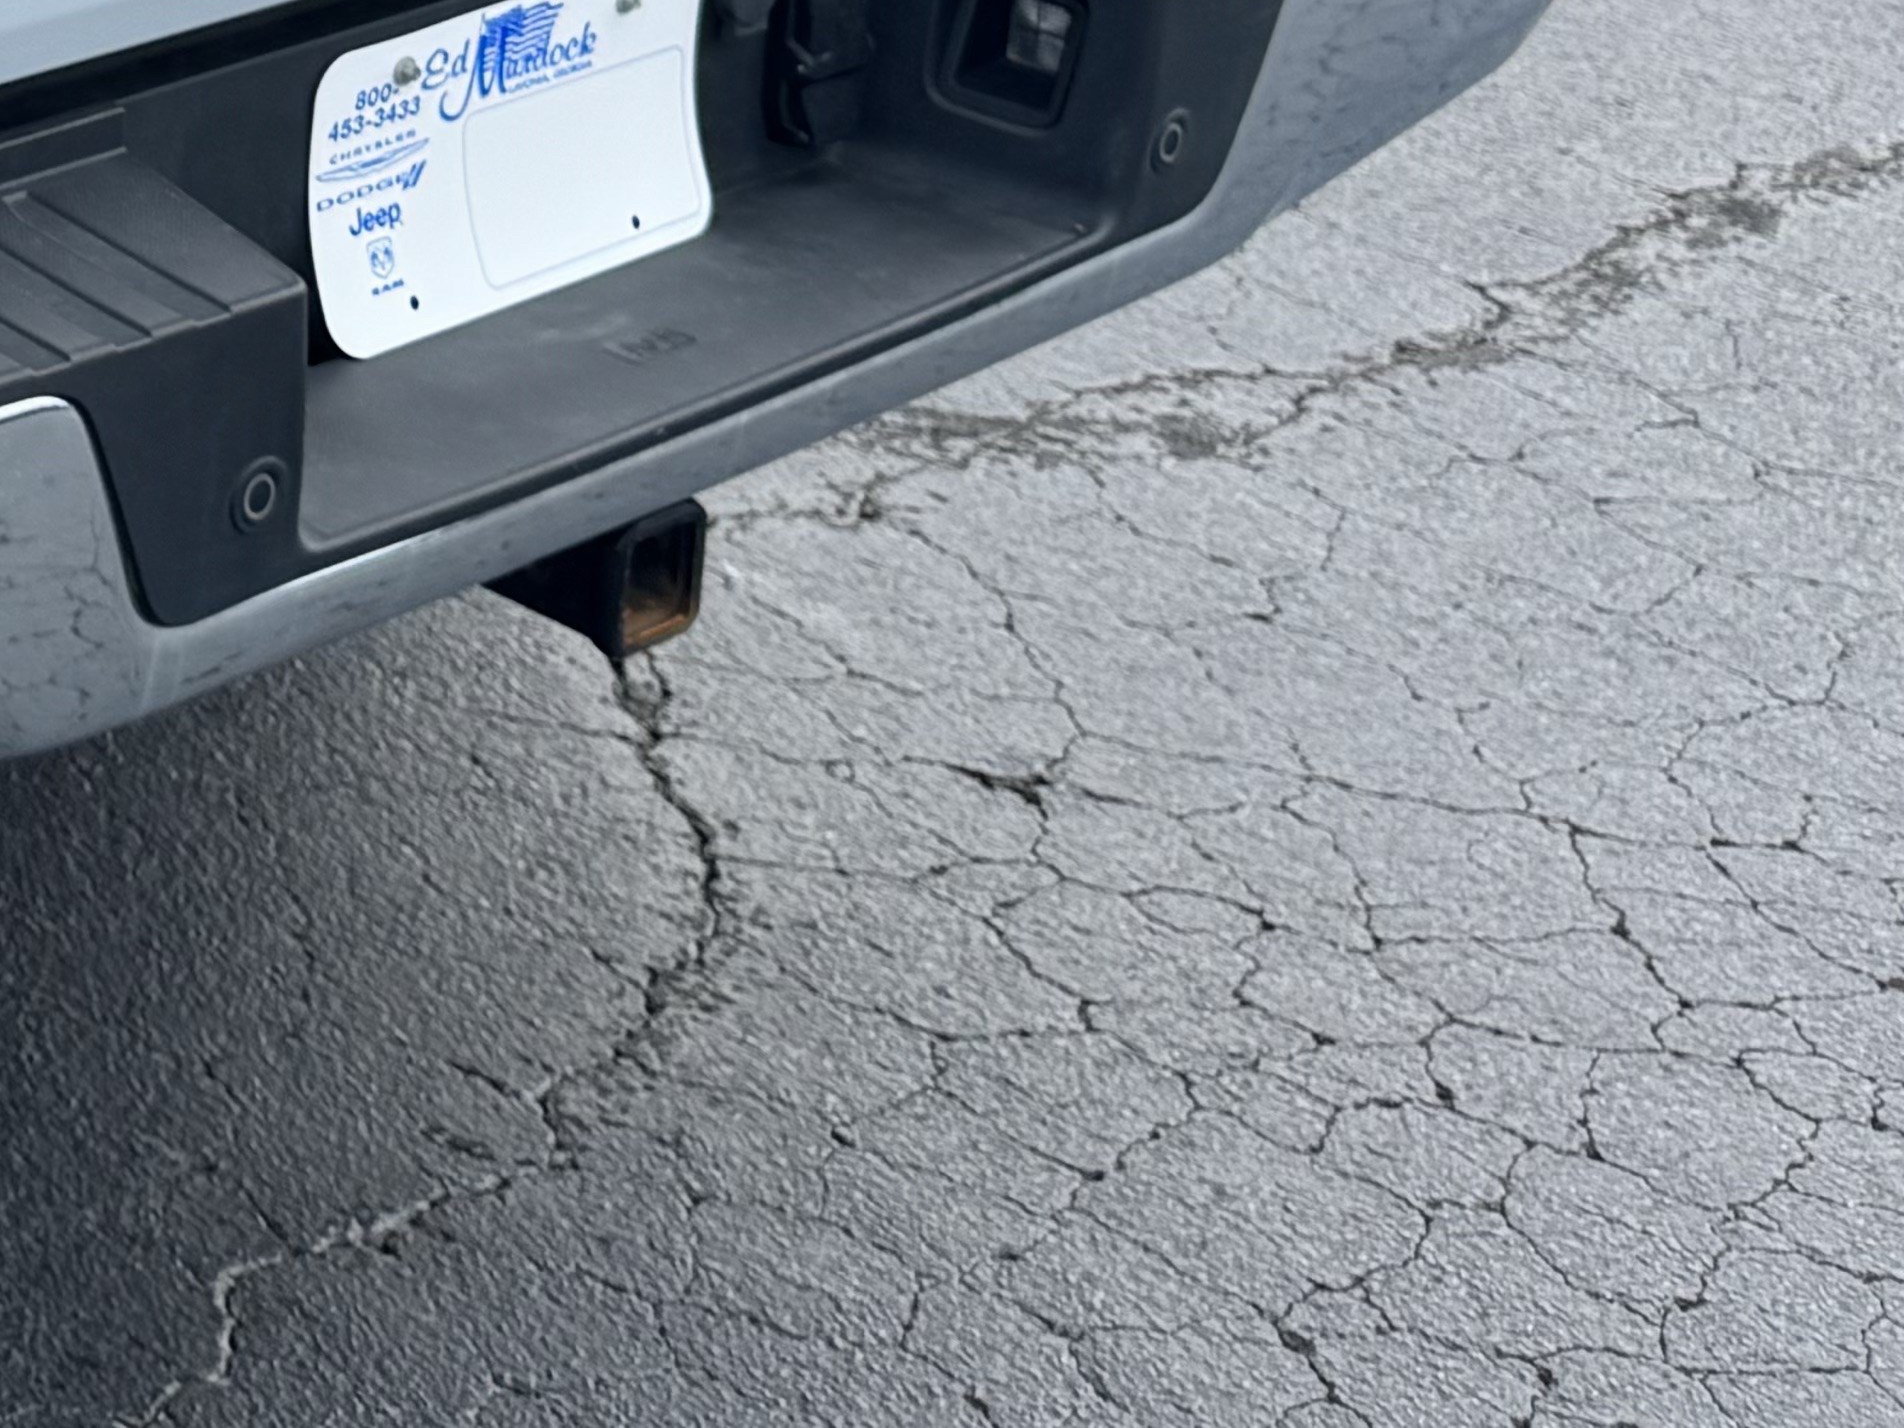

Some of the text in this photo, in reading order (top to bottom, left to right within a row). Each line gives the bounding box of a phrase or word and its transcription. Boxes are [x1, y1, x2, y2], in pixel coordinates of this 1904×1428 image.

[421, 20, 597, 122] Ed Murdock
[328, 94, 421, 143] 453-3433
[348, 202, 401, 237] Jeep
